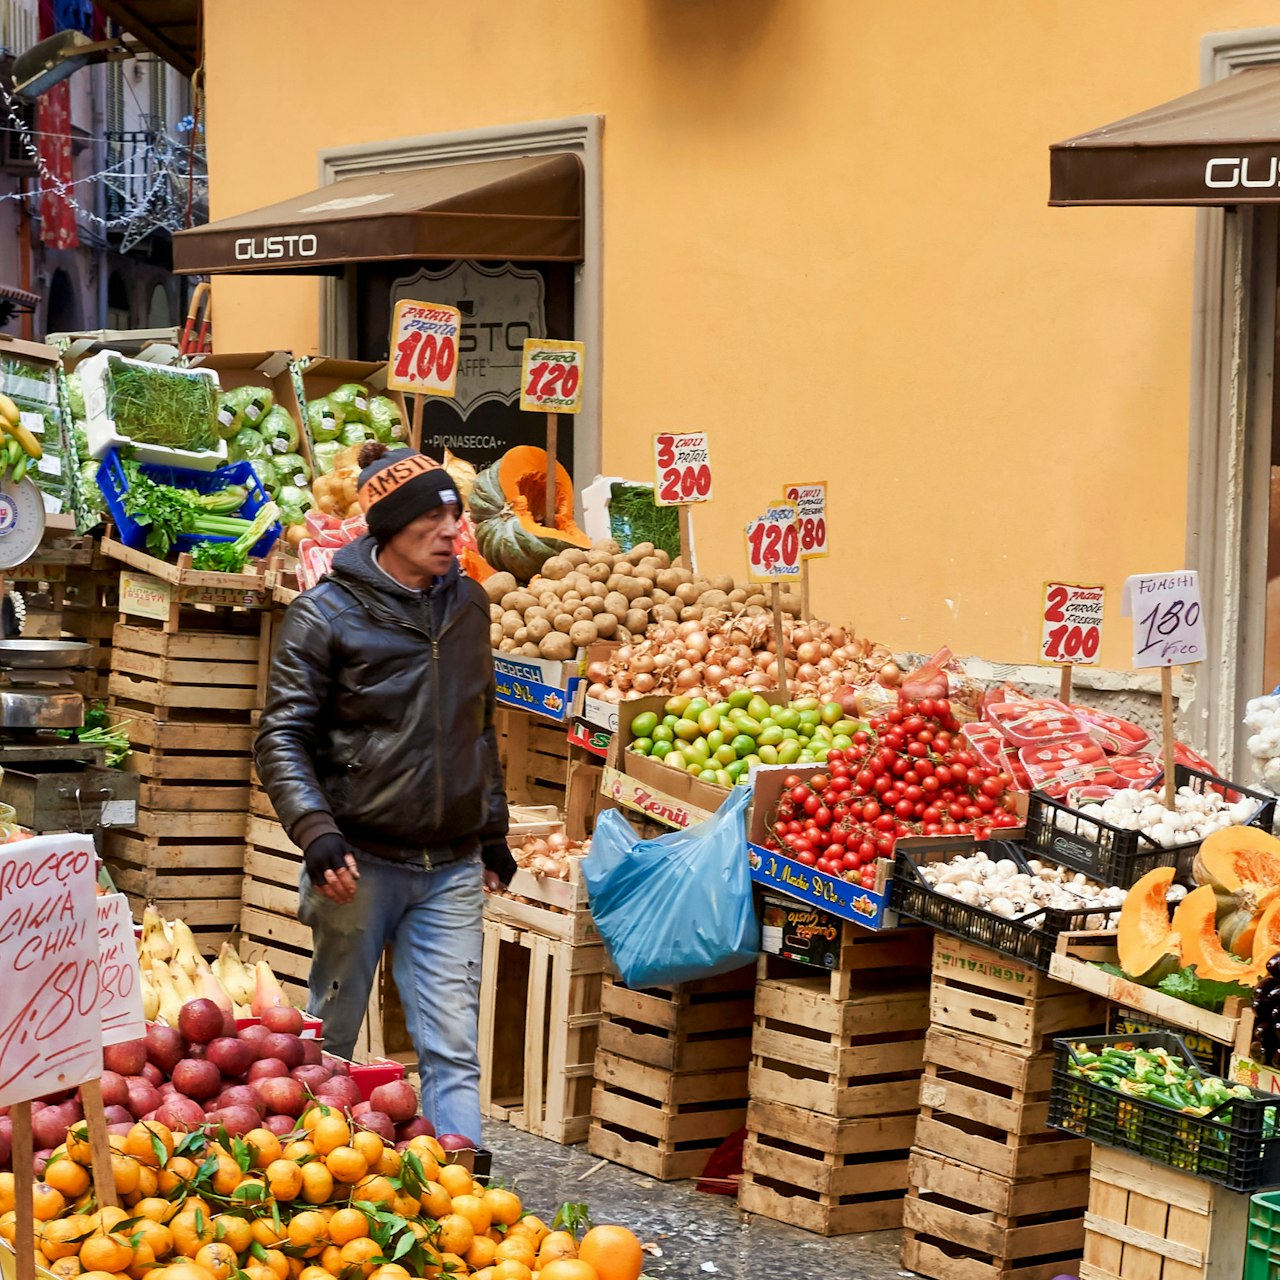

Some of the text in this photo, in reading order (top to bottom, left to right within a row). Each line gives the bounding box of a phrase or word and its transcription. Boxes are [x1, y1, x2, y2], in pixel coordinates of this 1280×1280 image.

[235, 234, 317, 260] GUSTO
[401, 308, 454, 323] PATATE
[403, 320, 457, 336] PEPITA
[460, 322, 532, 352] STO
[457, 358, 491, 377] AFFE'
[433, 434, 497, 449] PIGNASECCA
[657, 436, 675, 468] 3
[675, 449, 708, 466] PATATE
[200, 594, 266, 604] ASTER
[1044, 587, 1068, 622] 2
[634, 787, 690, 829] Zenit
